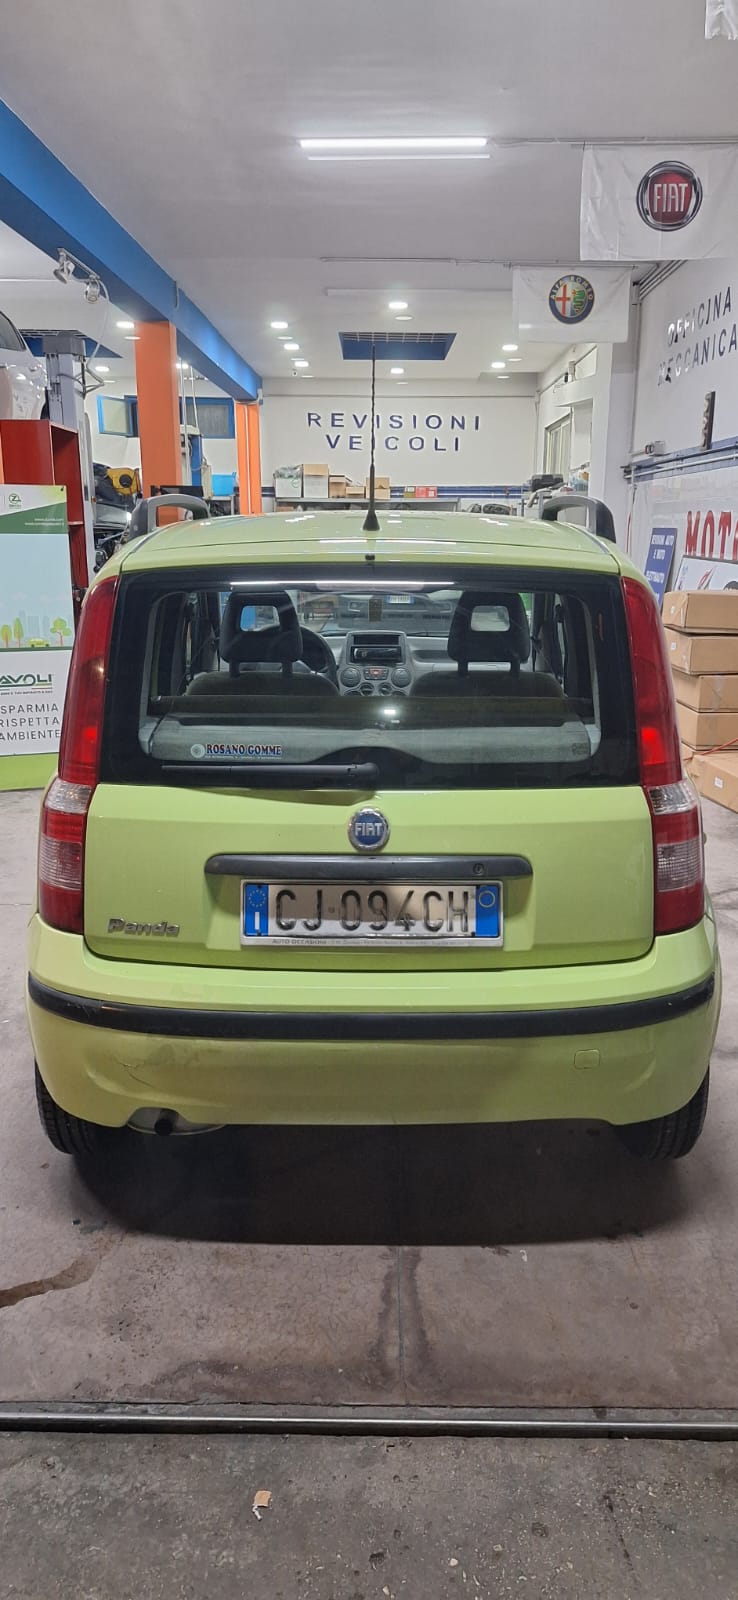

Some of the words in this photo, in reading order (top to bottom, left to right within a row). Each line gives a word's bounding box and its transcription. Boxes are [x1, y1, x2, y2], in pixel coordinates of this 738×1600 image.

[653, 183, 689, 213] FIAT
[307, 412, 479, 431] REVISIONI
[206, 743, 245, 755] ROSANO
[247, 744, 282, 756] GOMME
[355, 822, 382, 836] FIAT
[107, 918, 180, 938] Panda
